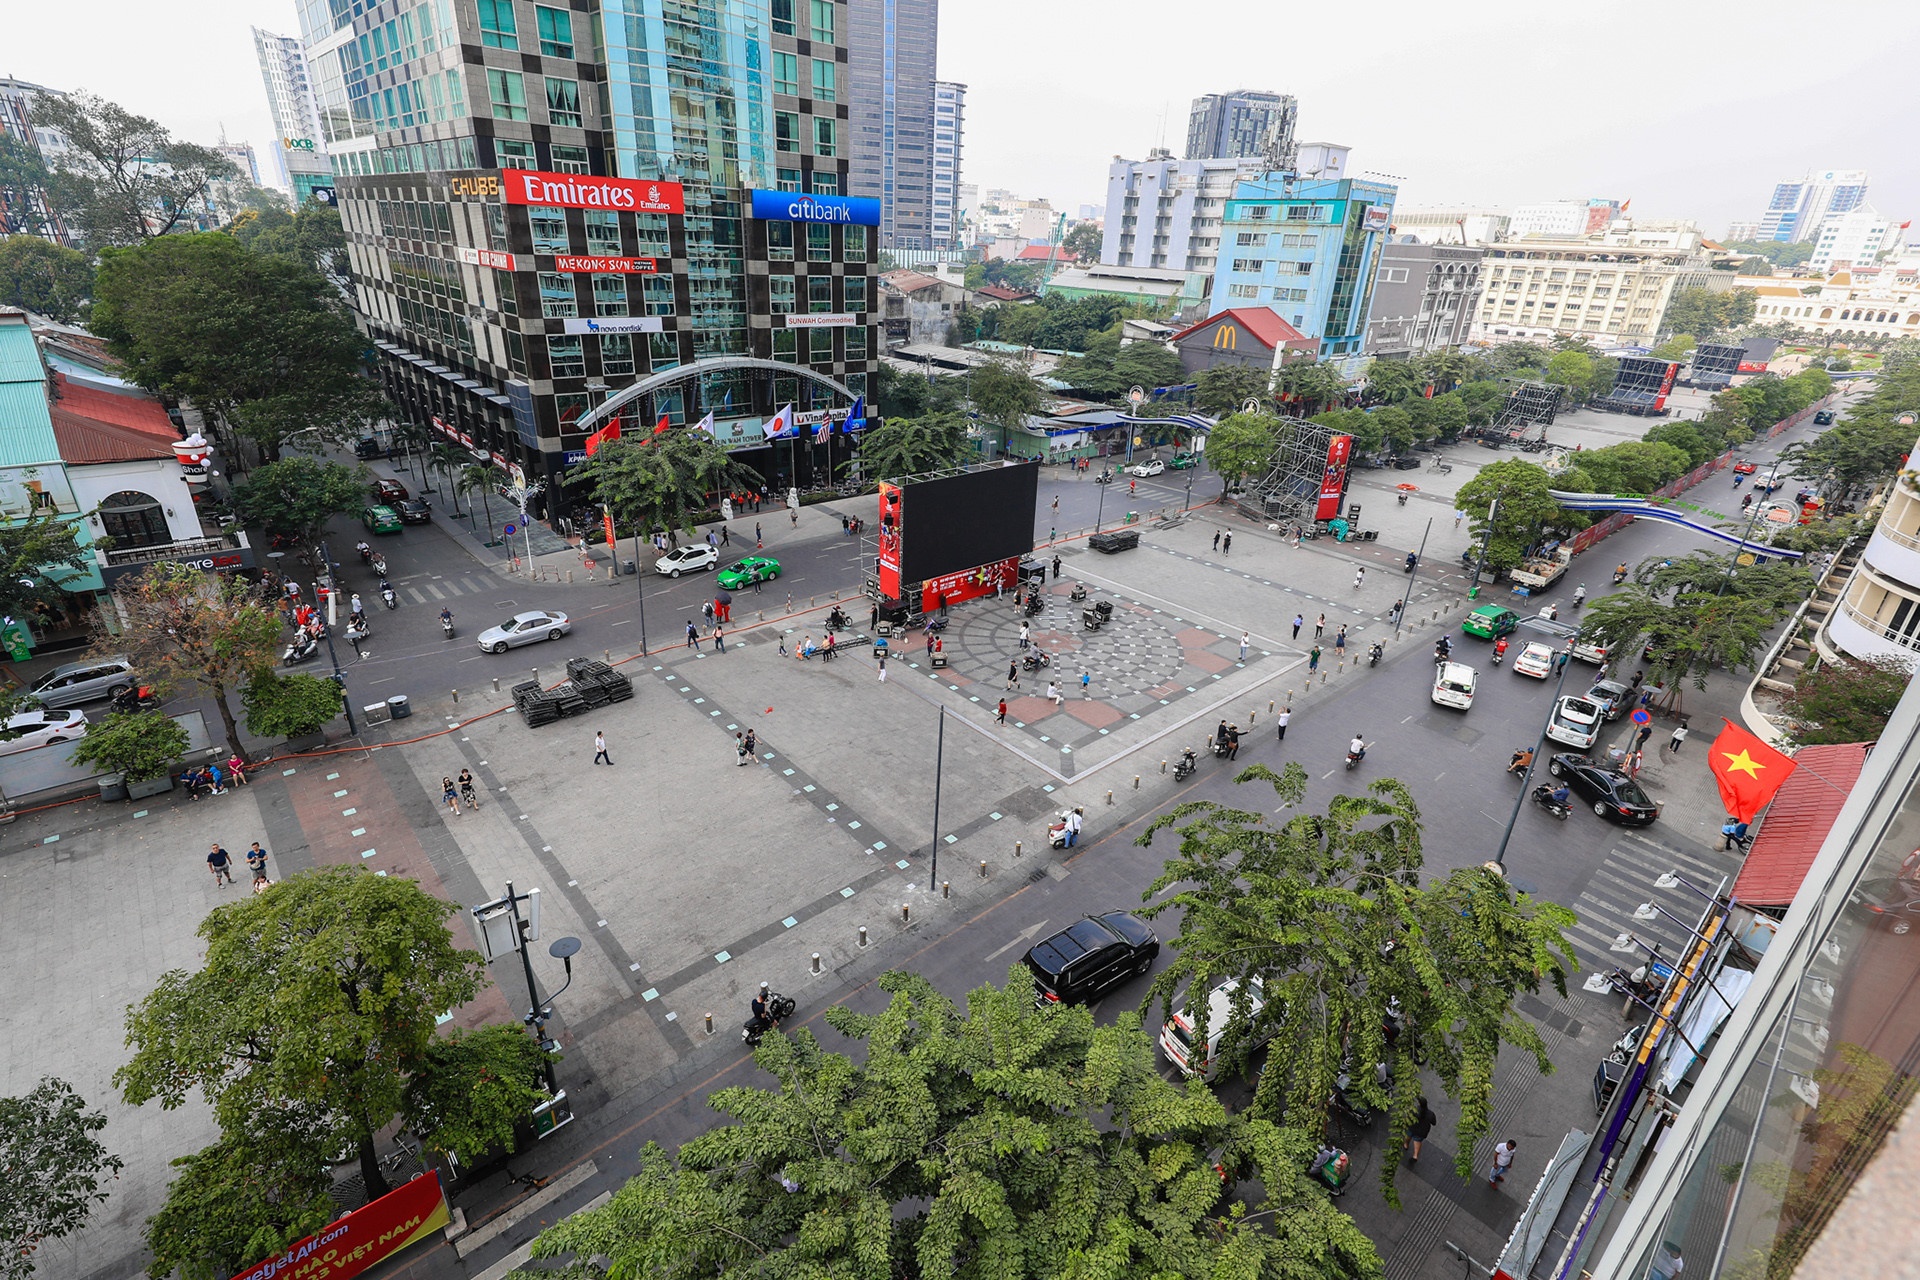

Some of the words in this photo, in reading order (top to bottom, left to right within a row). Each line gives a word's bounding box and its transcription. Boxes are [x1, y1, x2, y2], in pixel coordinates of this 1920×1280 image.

[291, 138, 314, 149] OCB
[451, 176, 499, 196] CHUBB
[522, 175, 635, 209] Emirates
[640, 200, 671, 210] Emirates
[788, 200, 851, 221] citibank
[480, 252, 490, 265] AIR
[490, 252, 508, 269] CHINA
[558, 258, 606, 270] MEKONG
[609, 260, 631, 270] SUN
[817, 315, 855, 325] Commodities
[600, 325, 618, 333] novo
[618, 323, 643, 333] nordisk
[728, 436, 742, 444] WAH
[742, 434, 762, 443] TOWER
[568, 455, 587, 463] KPM
[183, 465, 208, 473] Share
[333, 1238, 375, 1268] VIỆT
[378, 1214, 422, 1246] NAM
